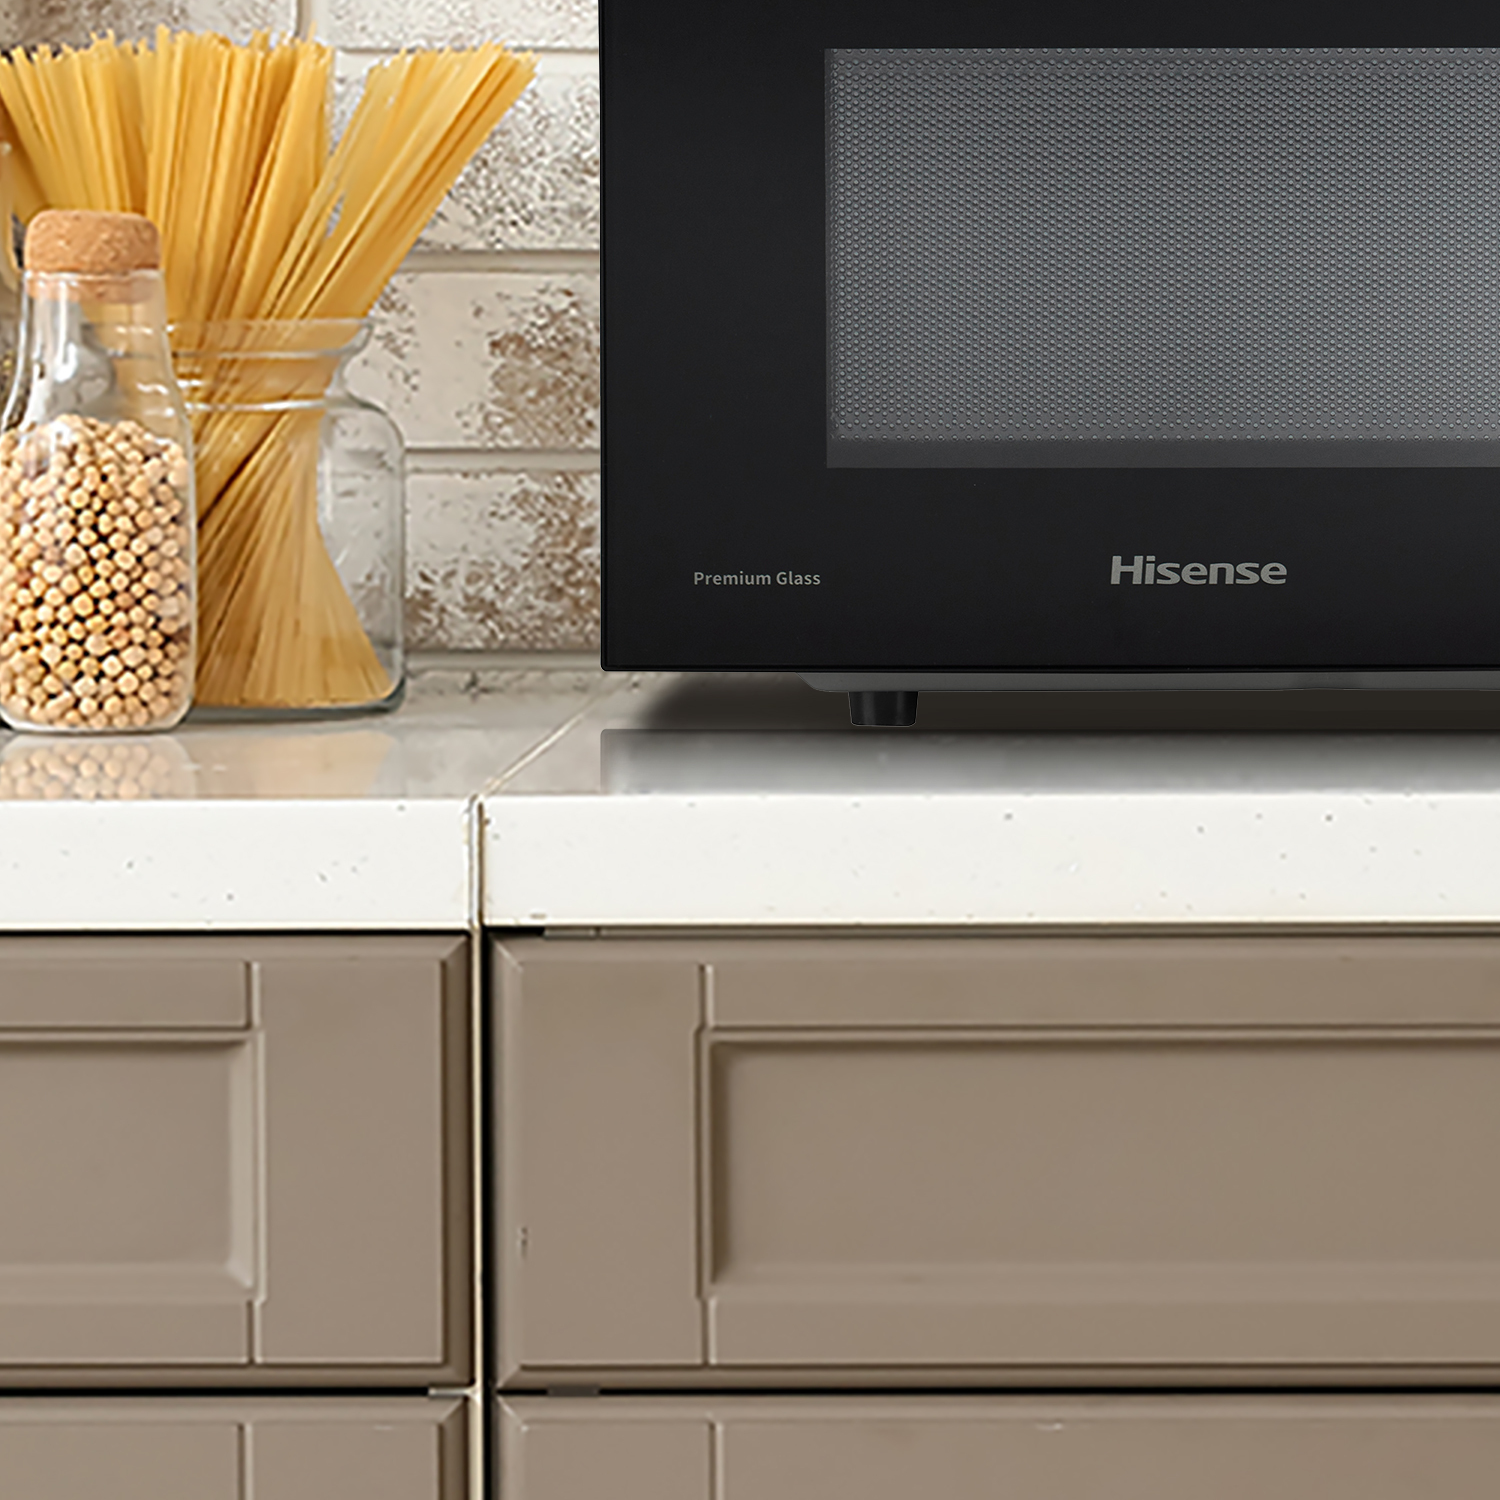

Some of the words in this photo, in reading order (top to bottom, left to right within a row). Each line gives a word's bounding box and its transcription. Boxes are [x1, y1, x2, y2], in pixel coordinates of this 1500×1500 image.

[694, 570, 772, 586] Premium
[776, 570, 821, 586] Glass
[1110, 555, 1288, 585] Hisense
